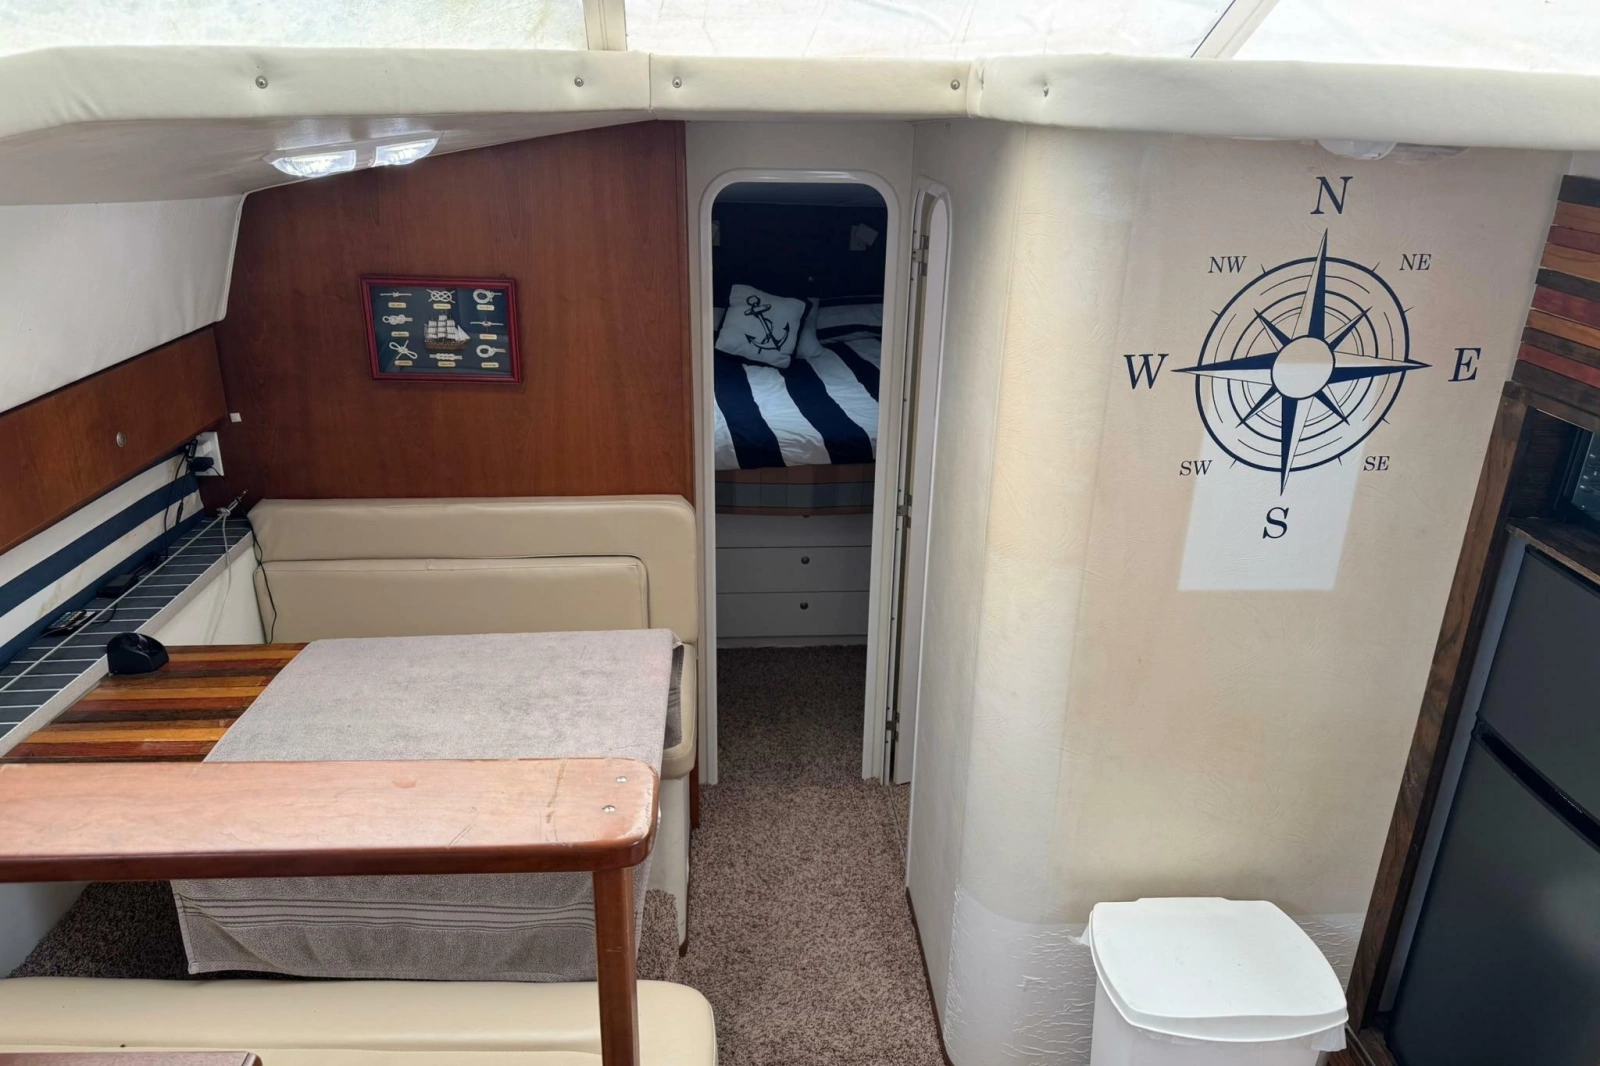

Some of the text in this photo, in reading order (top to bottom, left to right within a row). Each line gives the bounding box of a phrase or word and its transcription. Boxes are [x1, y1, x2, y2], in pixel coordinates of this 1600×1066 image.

[1310, 176, 1353, 215] N
[1207, 256, 1247, 274] NW
[1399, 253, 1432, 271] NE
[1123, 353, 1170, 390] W
[1447, 347, 1481, 382] E
[1179, 459, 1213, 476] SW
[1363, 455, 1390, 471] SE
[1262, 506, 1289, 539] S
